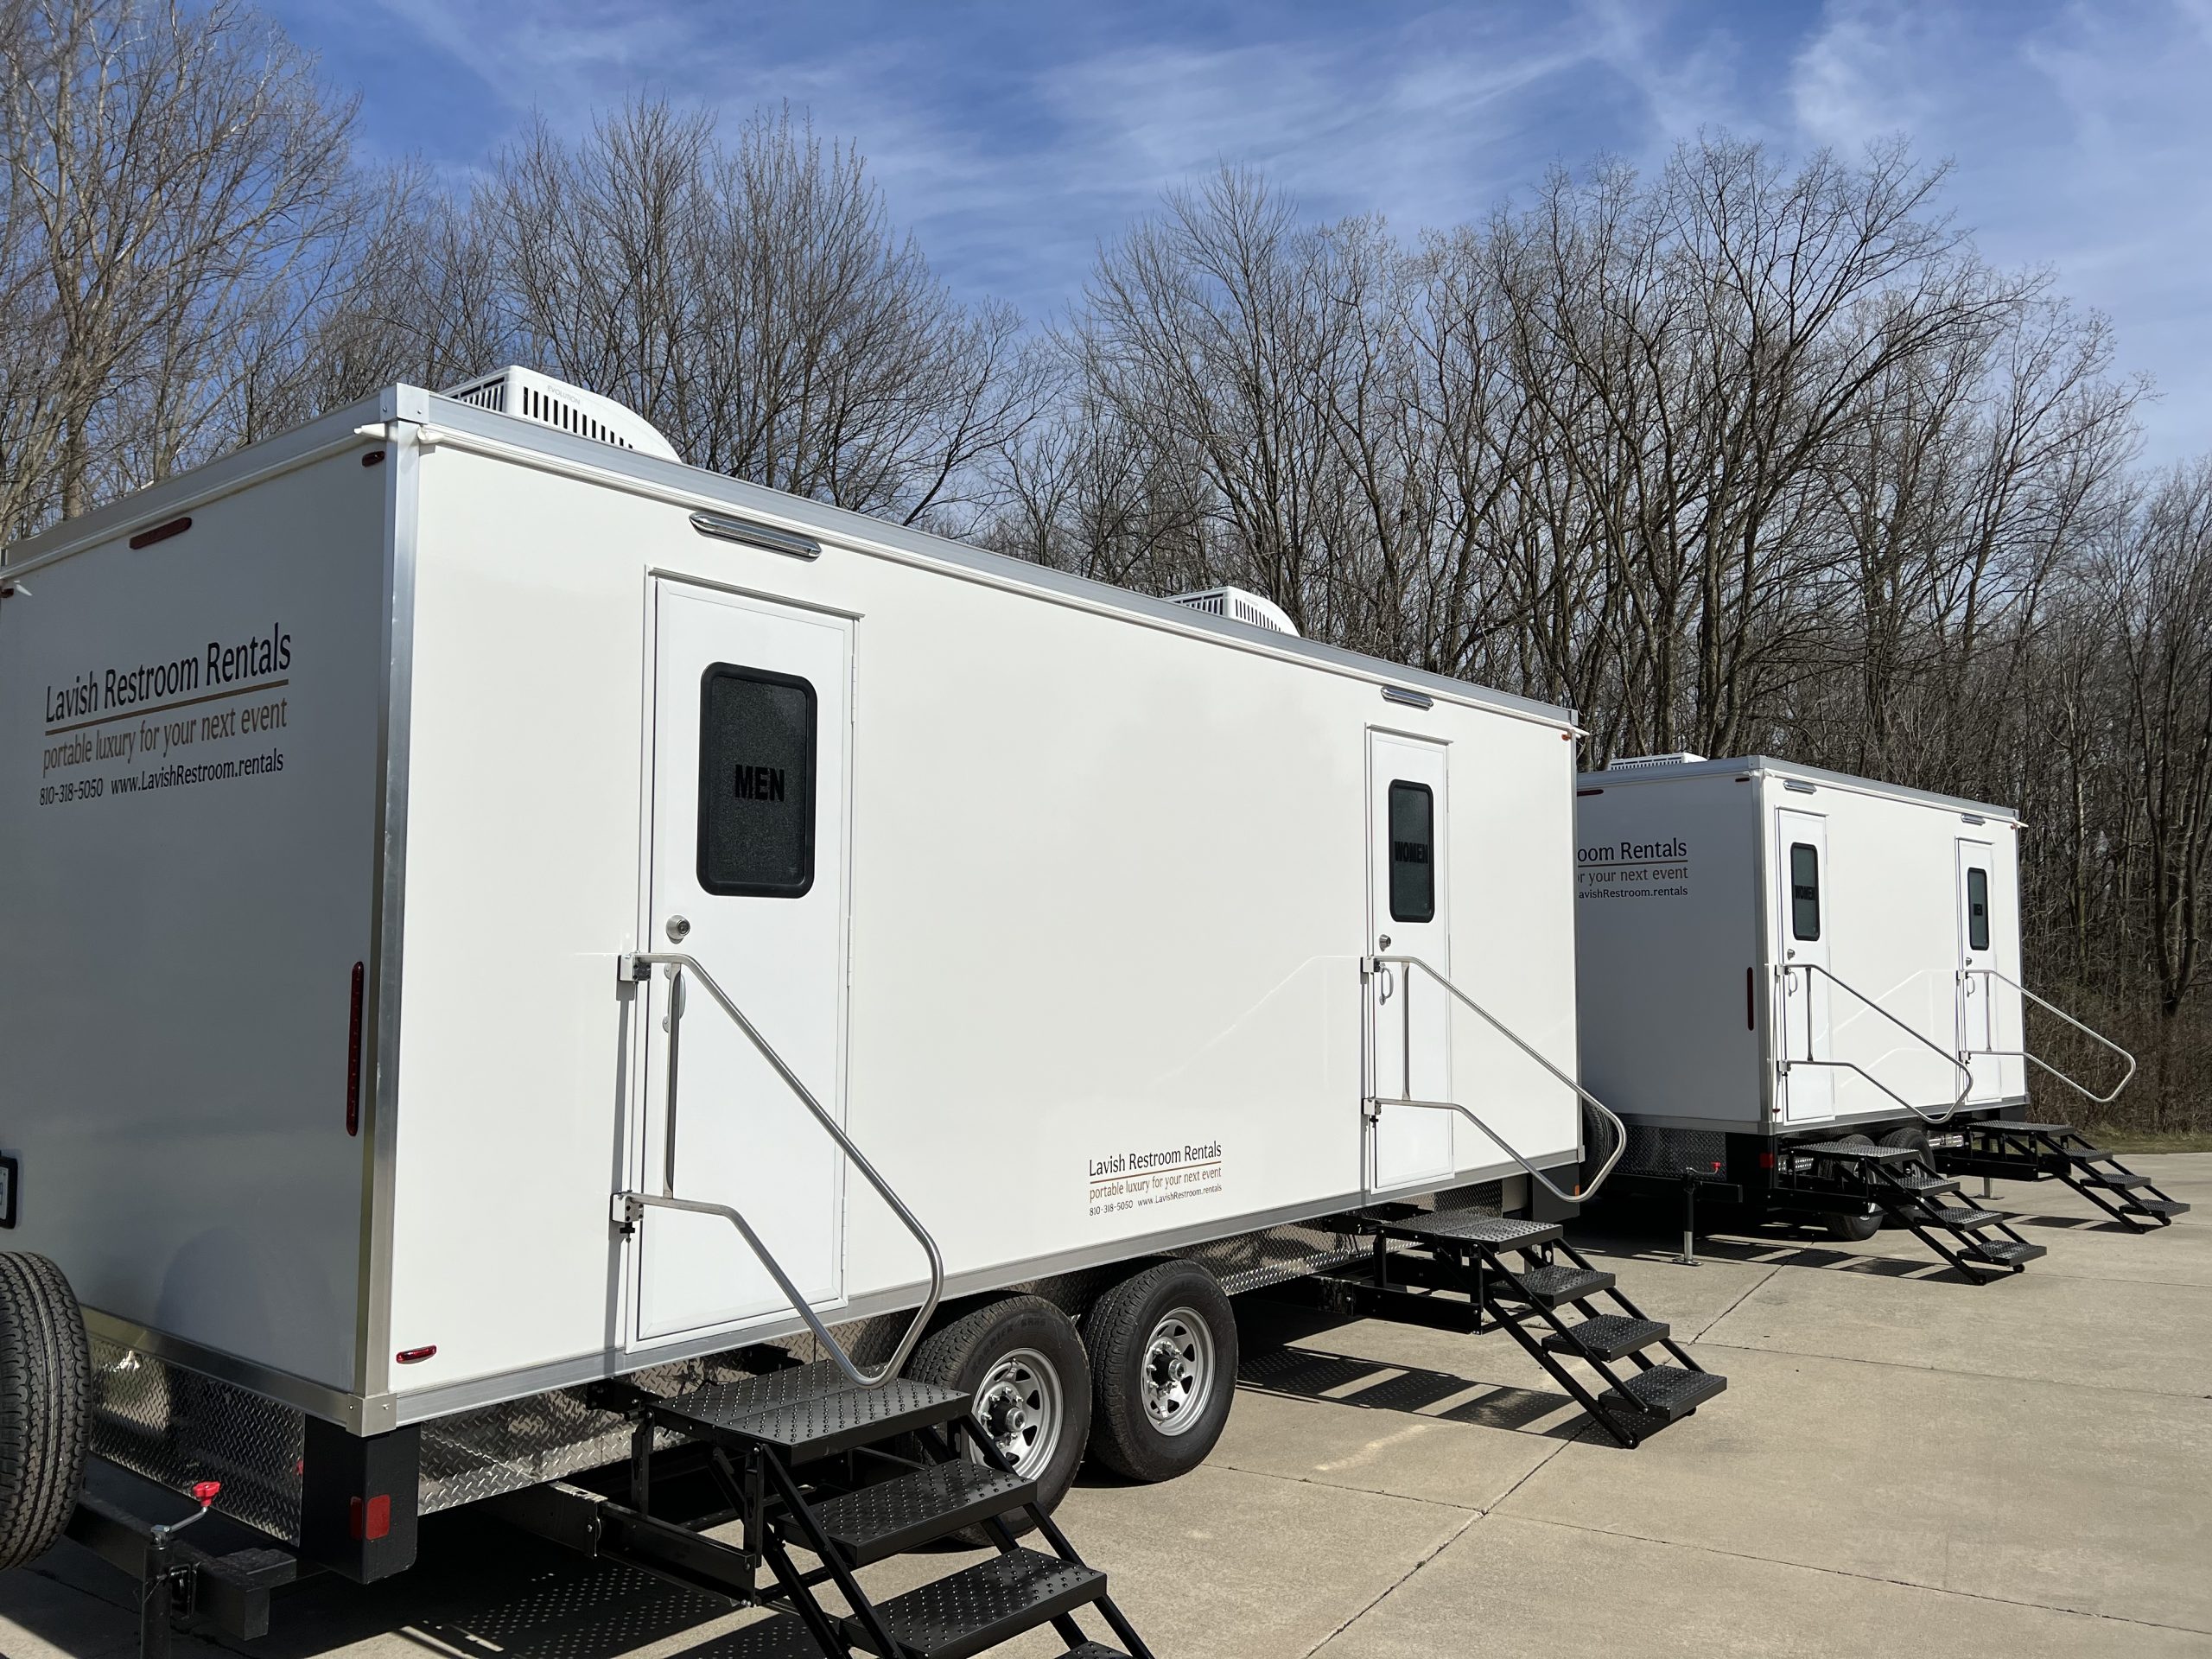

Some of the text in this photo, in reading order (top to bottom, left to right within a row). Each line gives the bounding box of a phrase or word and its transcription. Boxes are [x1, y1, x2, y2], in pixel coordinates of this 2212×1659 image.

[46, 622, 291, 723] Lavish Restroom Rentals
[42, 697, 288, 778] portable luxury for your next event
[39, 747, 283, 806] 810-318-5050 www.LavishRestroom.rentals
[734, 764, 785, 802] MEN
[1394, 841, 1428, 864] WOMEN
[1578, 837, 1688, 862] oom Rentals
[1579, 886, 1688, 899] avishRestroom.rentals
[1588, 871, 1616, 887] your
[1620, 868, 1648, 881] next
[1652, 867, 1688, 880] event
[1089, 1141, 1222, 1176] Lavish Restroom Rentals
[1089, 1184, 1223, 1217] 810-318-5050 www.LavishRestroom.rentals
[1090, 1167, 1222, 1203] portable luxury for your next event
